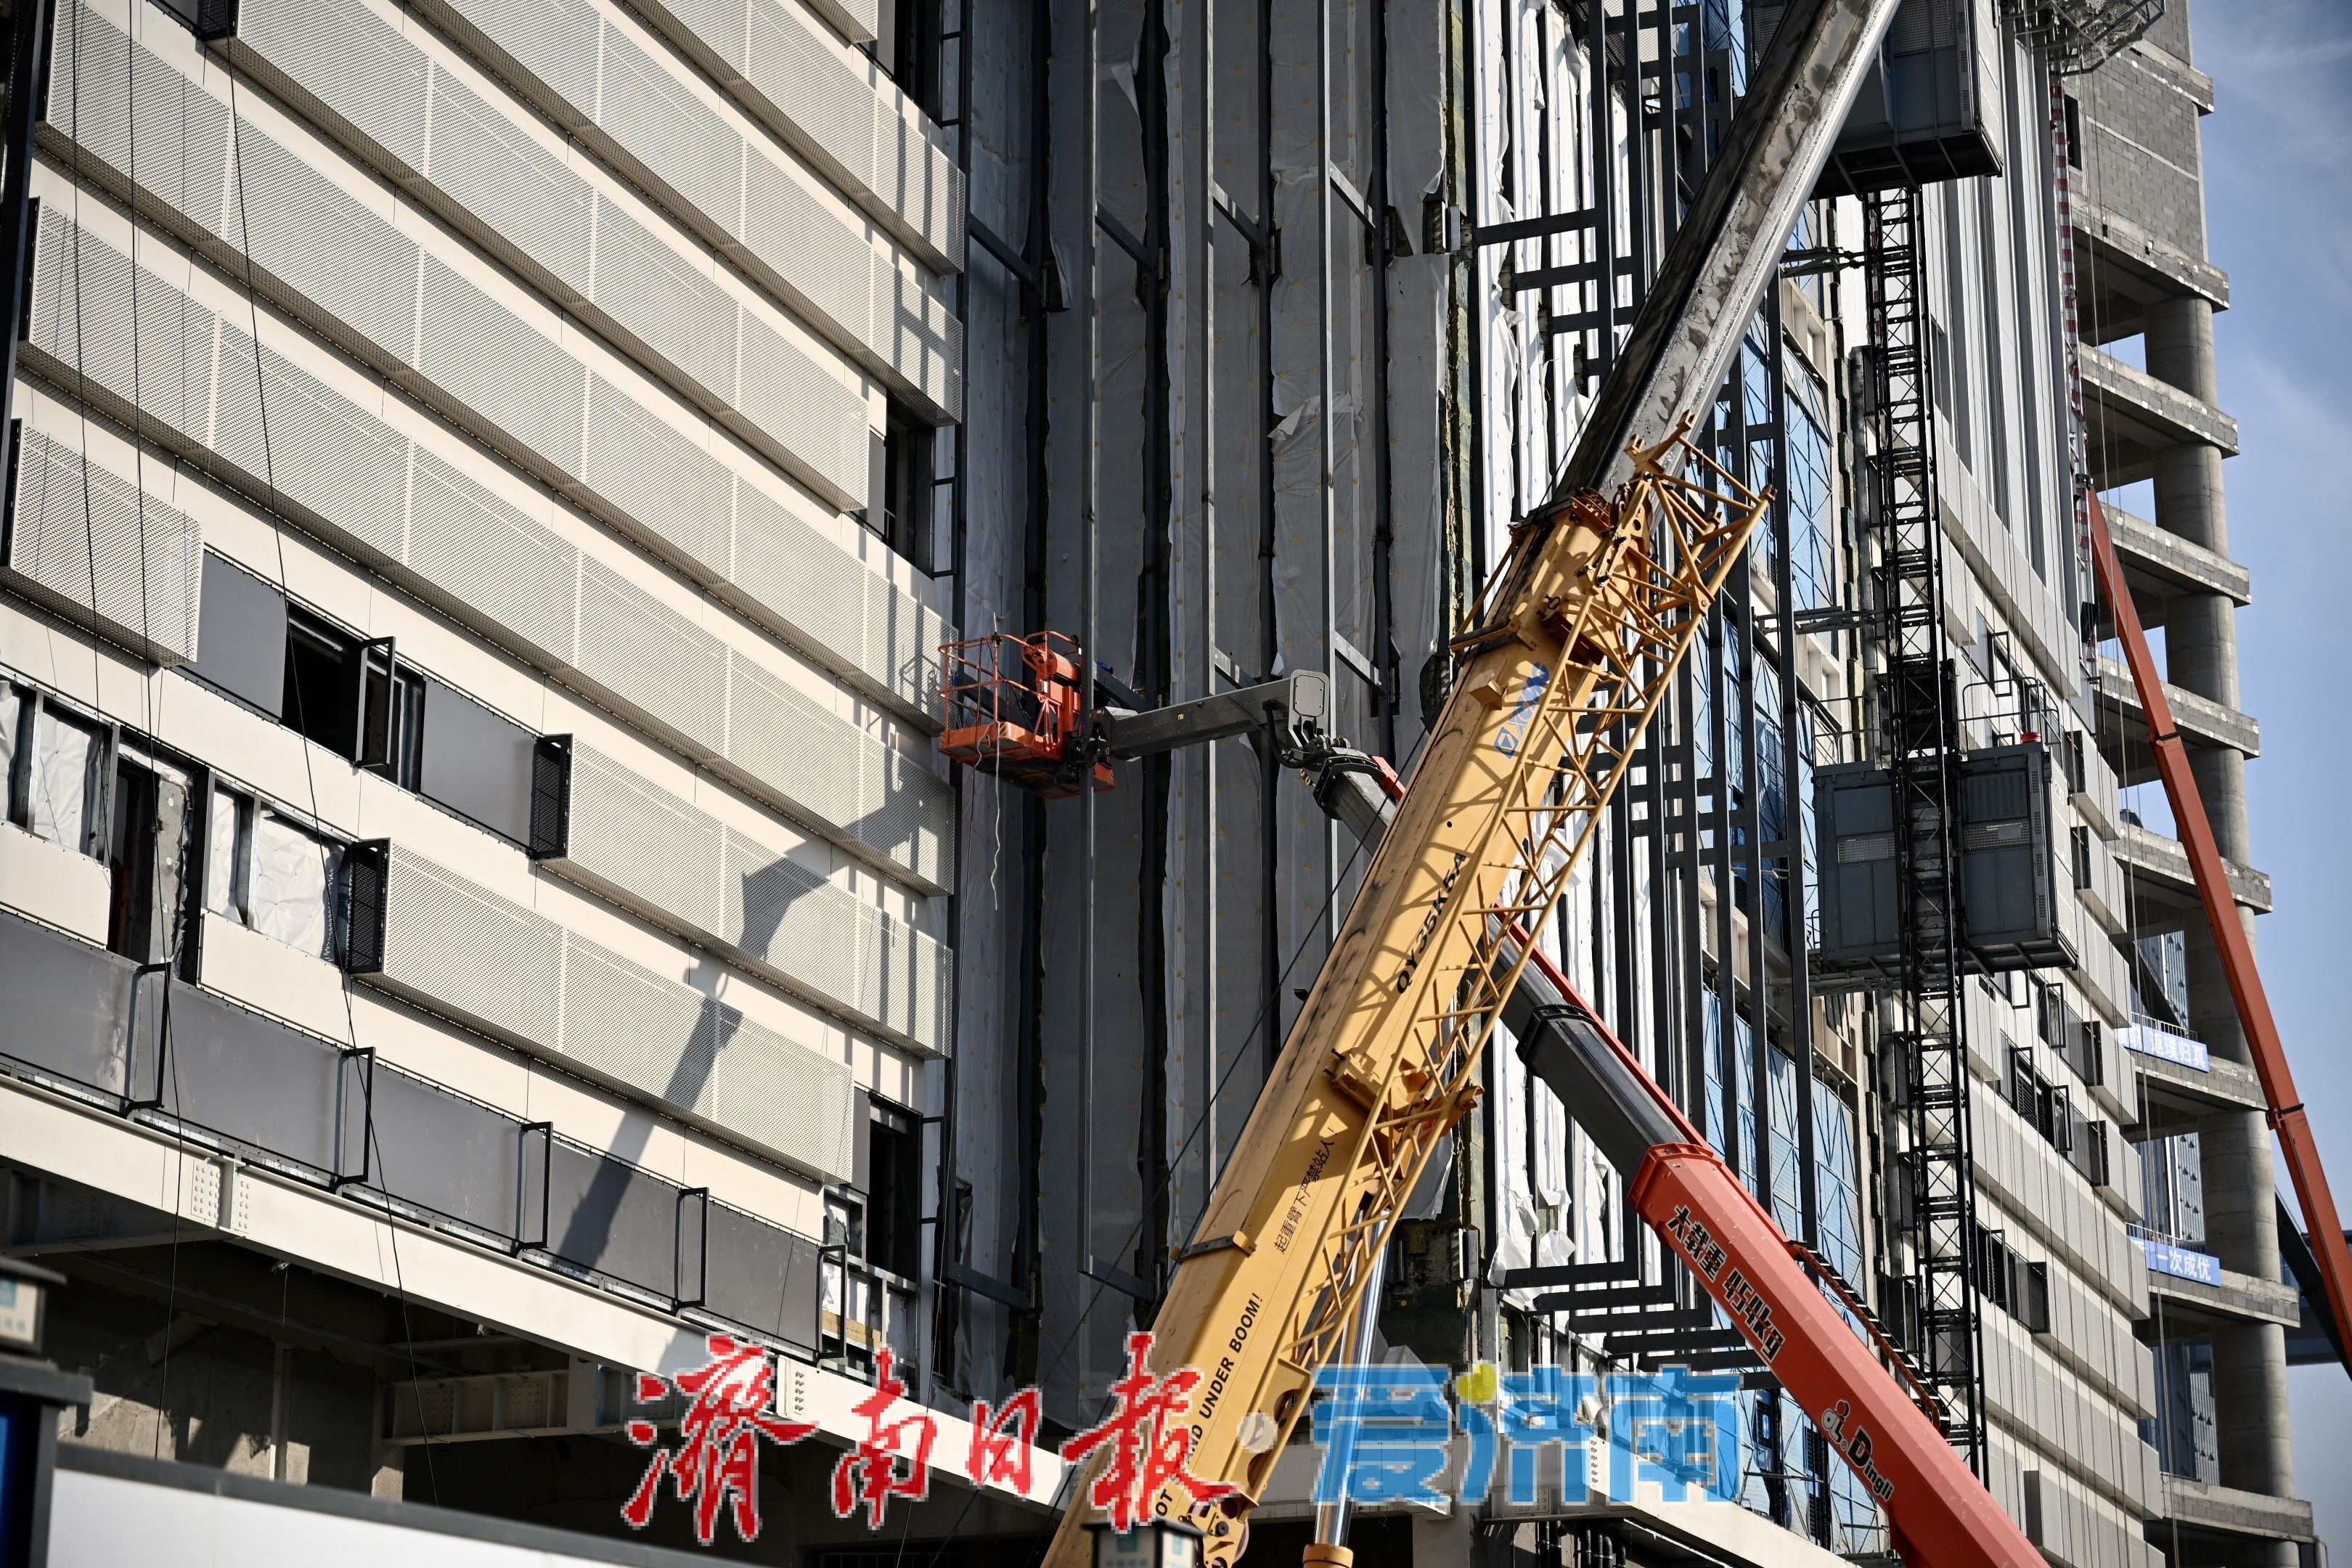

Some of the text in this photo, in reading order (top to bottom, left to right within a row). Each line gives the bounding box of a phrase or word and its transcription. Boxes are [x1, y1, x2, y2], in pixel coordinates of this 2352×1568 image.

[1397, 852, 1467, 994] QY35K5A
[2150, 1032, 2206, 1069] 返璞归真
[2157, 1249, 2211, 1281] 一次成优
[1199, 1356, 1235, 1419] UNDER
[1228, 1292, 1263, 1355] BOOM!
[1722, 1267, 1786, 1364] 454kg
[1846, 1425, 1895, 1502] Dingli
